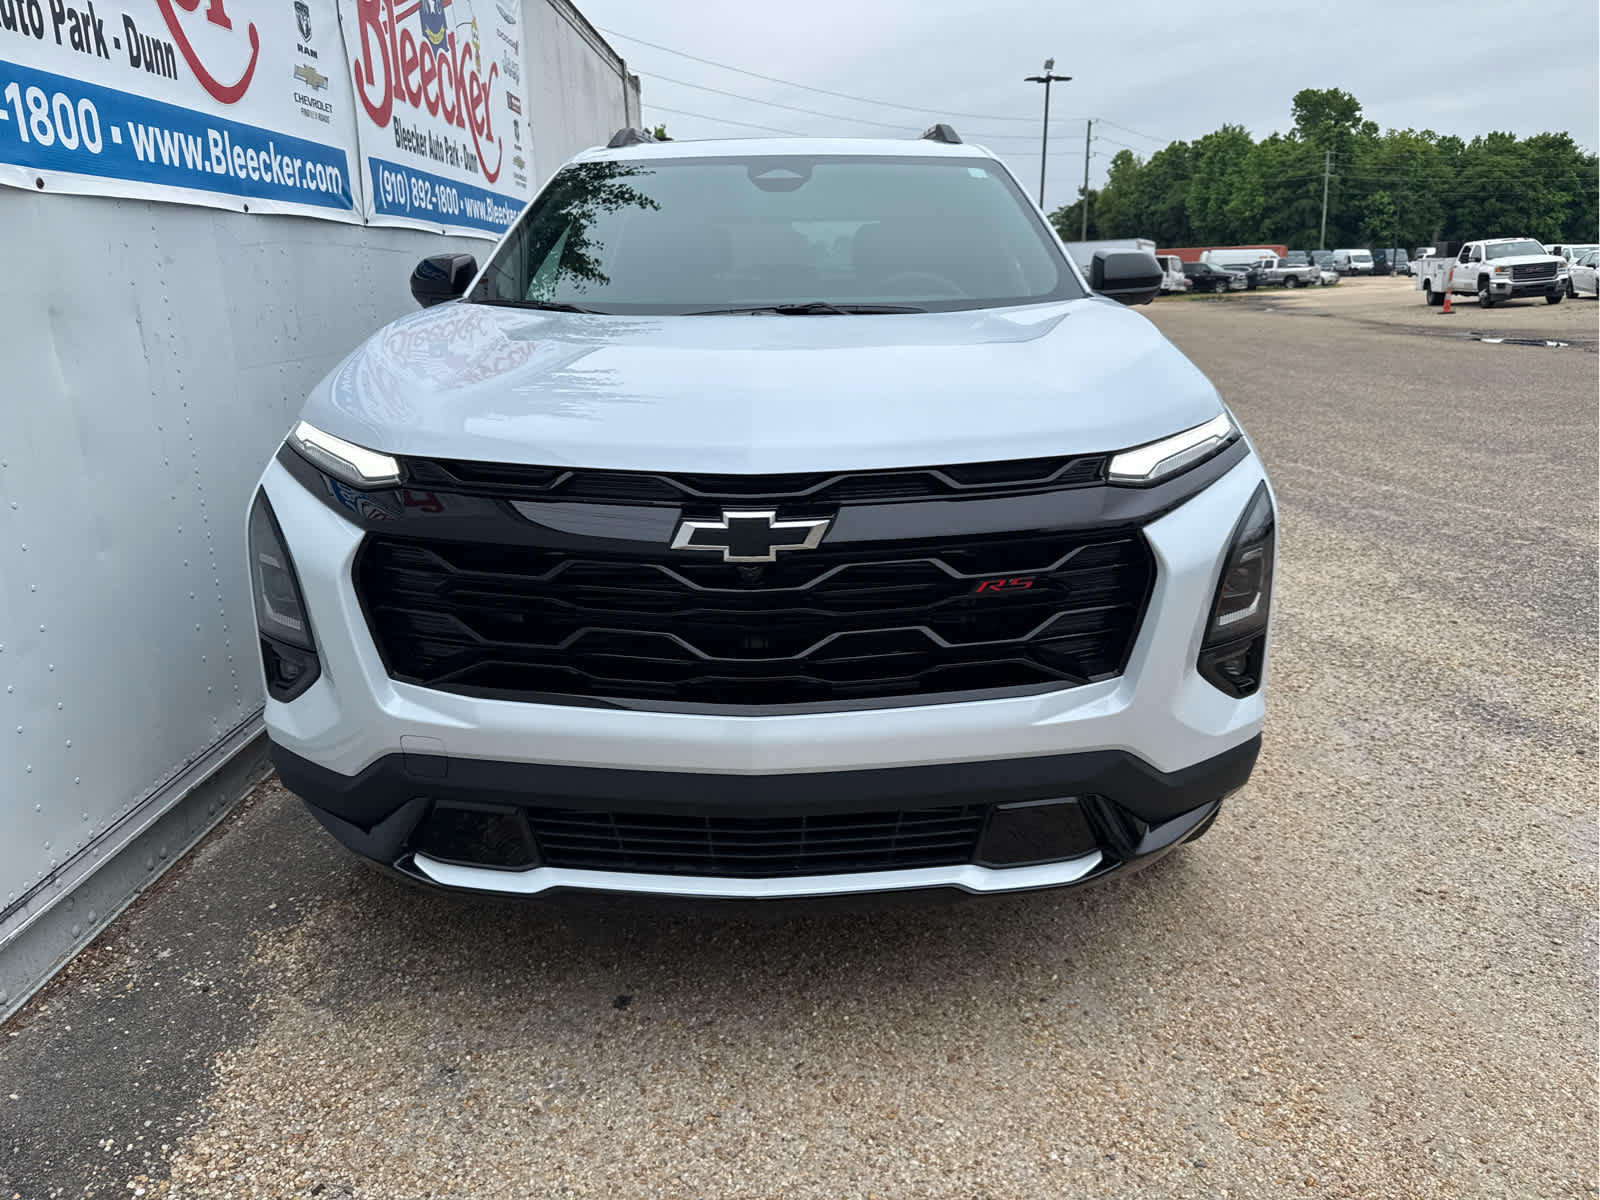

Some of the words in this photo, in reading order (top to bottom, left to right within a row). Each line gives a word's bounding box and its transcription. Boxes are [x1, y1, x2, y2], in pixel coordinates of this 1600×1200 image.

[0, 0, 44, 40] uto
[48, 0, 110, 60] Park
[121, 12, 178, 81] Dunn
[296, 43, 319, 59] RAM
[293, 91, 334, 114] CHEVROLET
[127, 121, 343, 196] www.Bleecker.com
[392, 115, 427, 158] Bleecker
[428, 129, 445, 164] Auto
[444, 135, 461, 169] Park
[463, 143, 479, 174] Dunn
[379, 164, 410, 213] (910)
[410, 177, 460, 216] 892-1800
[975, 576, 1036, 593] RS
